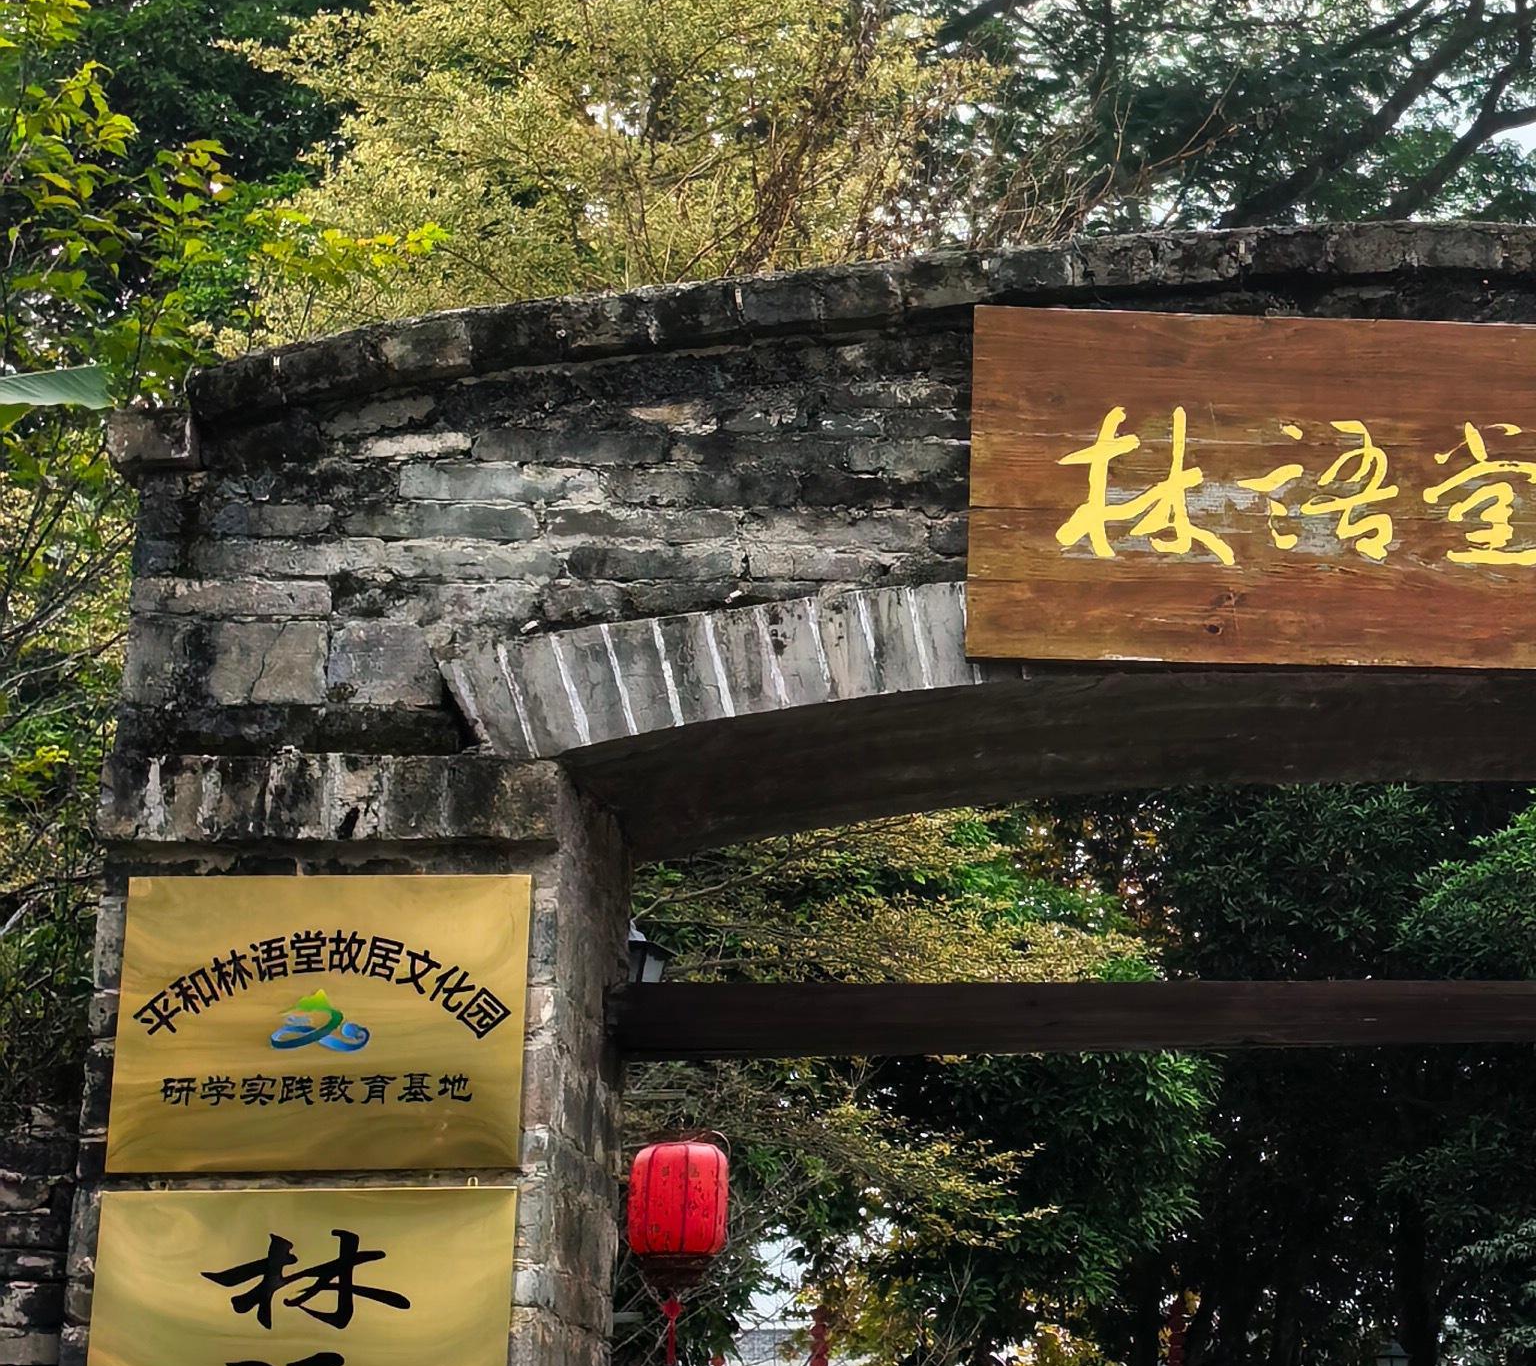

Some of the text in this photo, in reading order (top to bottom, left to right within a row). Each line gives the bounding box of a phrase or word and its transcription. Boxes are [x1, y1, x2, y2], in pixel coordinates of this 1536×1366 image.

[132, 929, 512, 1039] 平和林语堂故居文化园
[160, 1072, 474, 1106] 研学实践教育基地
